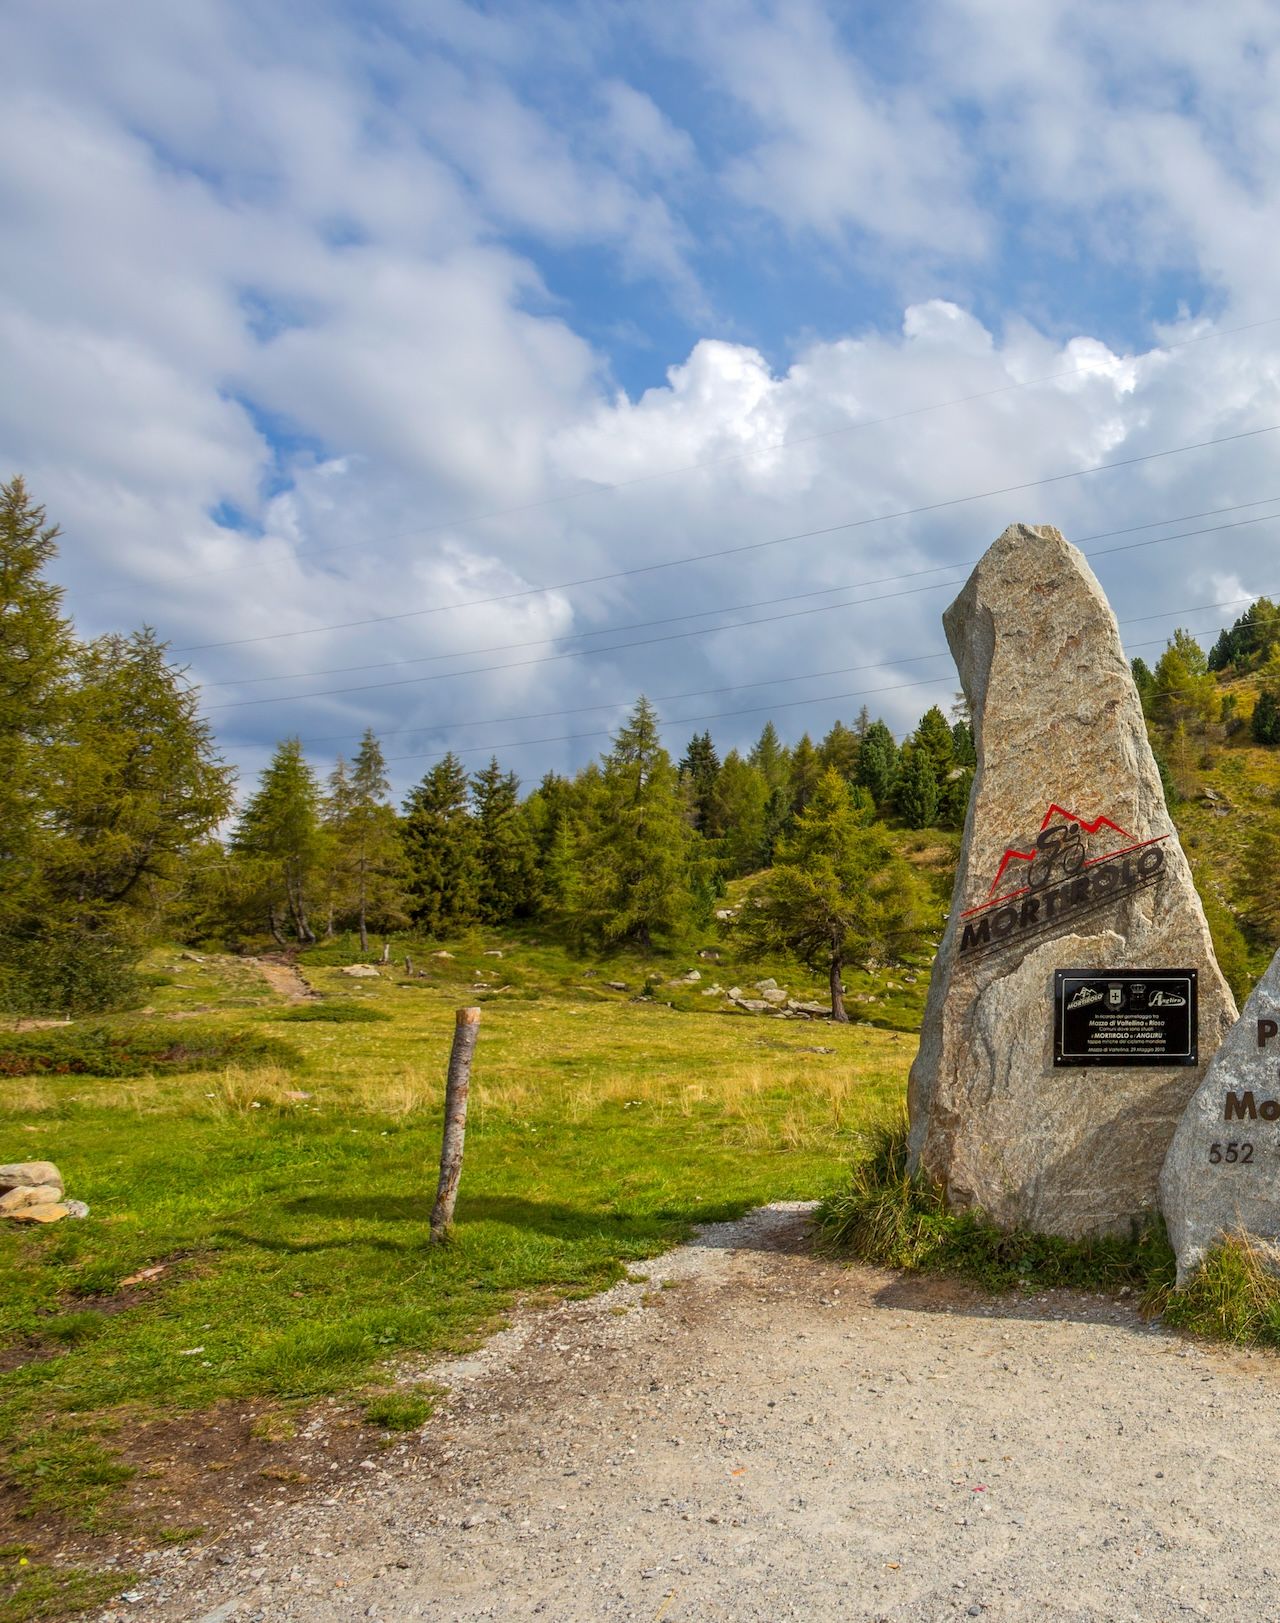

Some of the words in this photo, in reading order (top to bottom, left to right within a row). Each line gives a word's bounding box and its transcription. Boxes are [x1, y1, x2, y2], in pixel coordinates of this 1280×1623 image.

[960, 847, 1165, 952] MORTIROLO
[1067, 992, 1103, 1010] MORTIROLO
[1209, 1143, 1254, 1164] 552
